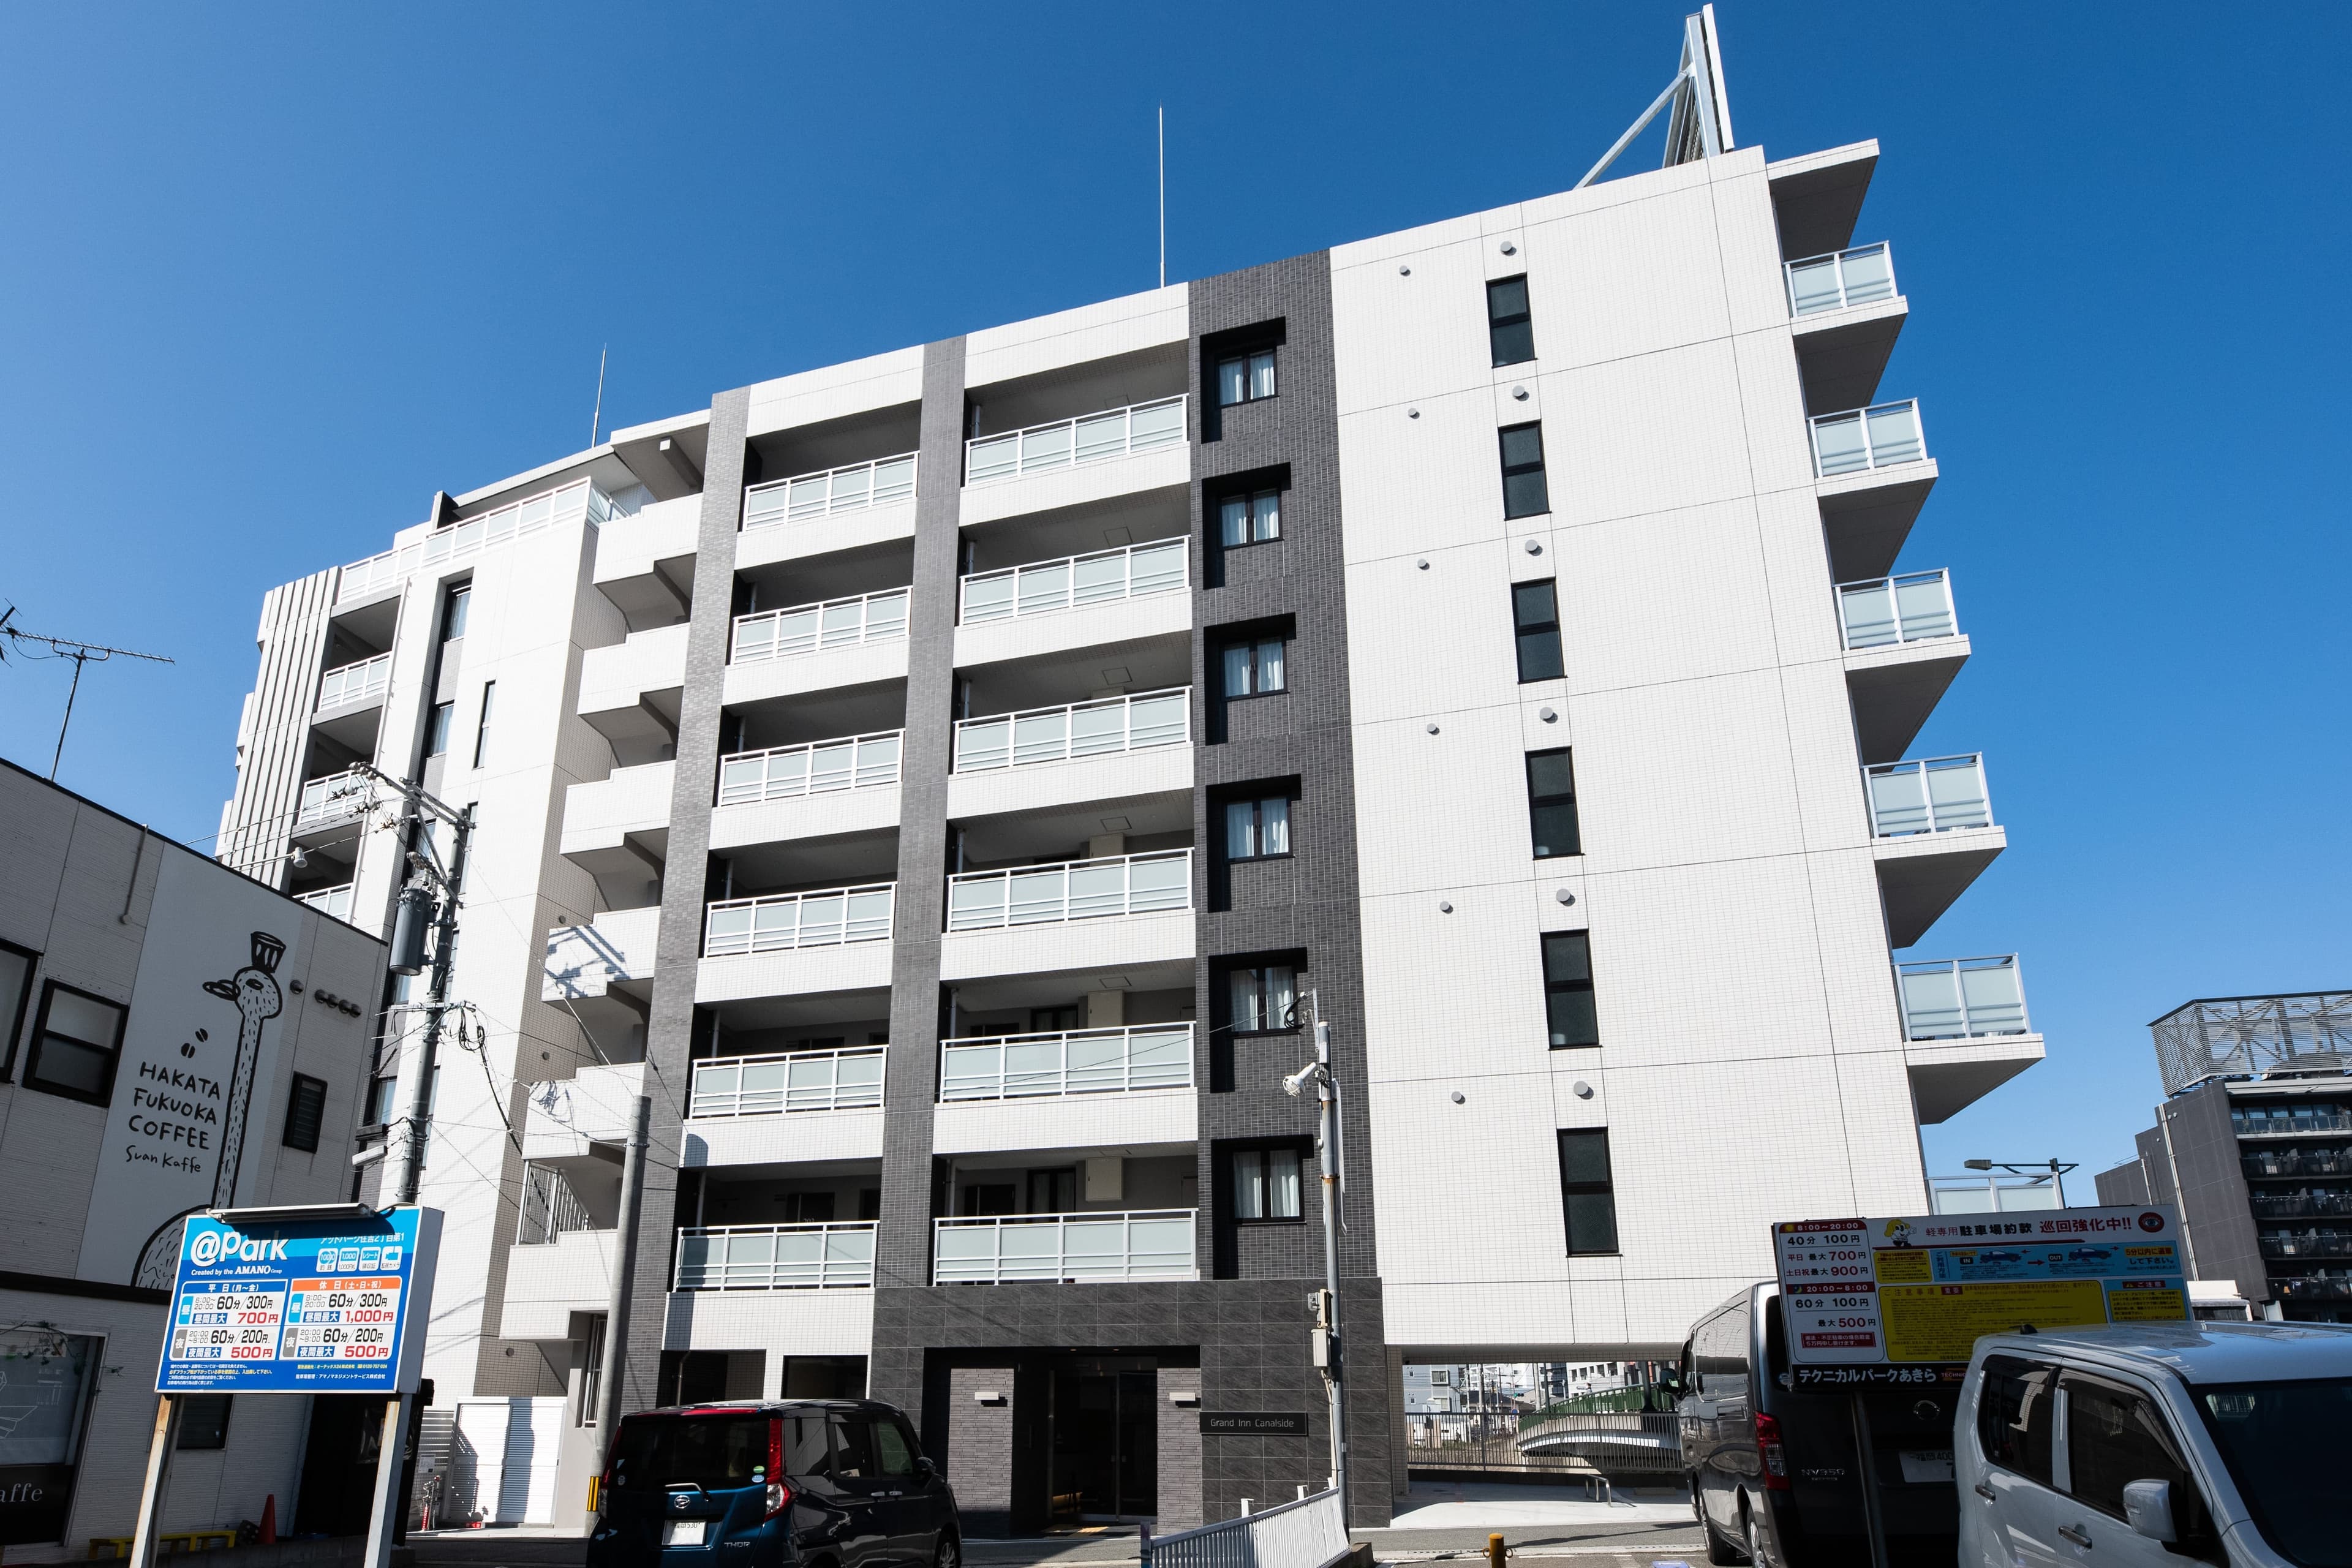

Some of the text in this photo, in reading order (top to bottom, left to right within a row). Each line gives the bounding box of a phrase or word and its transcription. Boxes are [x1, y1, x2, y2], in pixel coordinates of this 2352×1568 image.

[139, 1061, 220, 1101] HAKATA
[133, 1087, 217, 1125] FUKUOKA
[129, 1115, 209, 1150] COFFEE
[162, 1152, 201, 1173] Kaffe
[2040, 1217, 2132, 1233] 巡回強化中!!
[1787, 1234, 1861, 1246] 40分 100円
[235, 1265, 271, 1275] AMANO
[1795, 1297, 1869, 1308] 60分 100円
[237, 1312, 279, 1324] 700円
[345, 1310, 394, 1323] 1,000円
[175, 1338, 184, 1349] 夜
[285, 1336, 295, 1348] 夜
[231, 1347, 273, 1358] 500円
[344, 1346, 388, 1358] 500円
[1798, 1368, 1937, 1383] テクニカルパークあきら
[1238, 1419, 1251, 1427] Inn
[1255, 1419, 1294, 1428] Canalside
